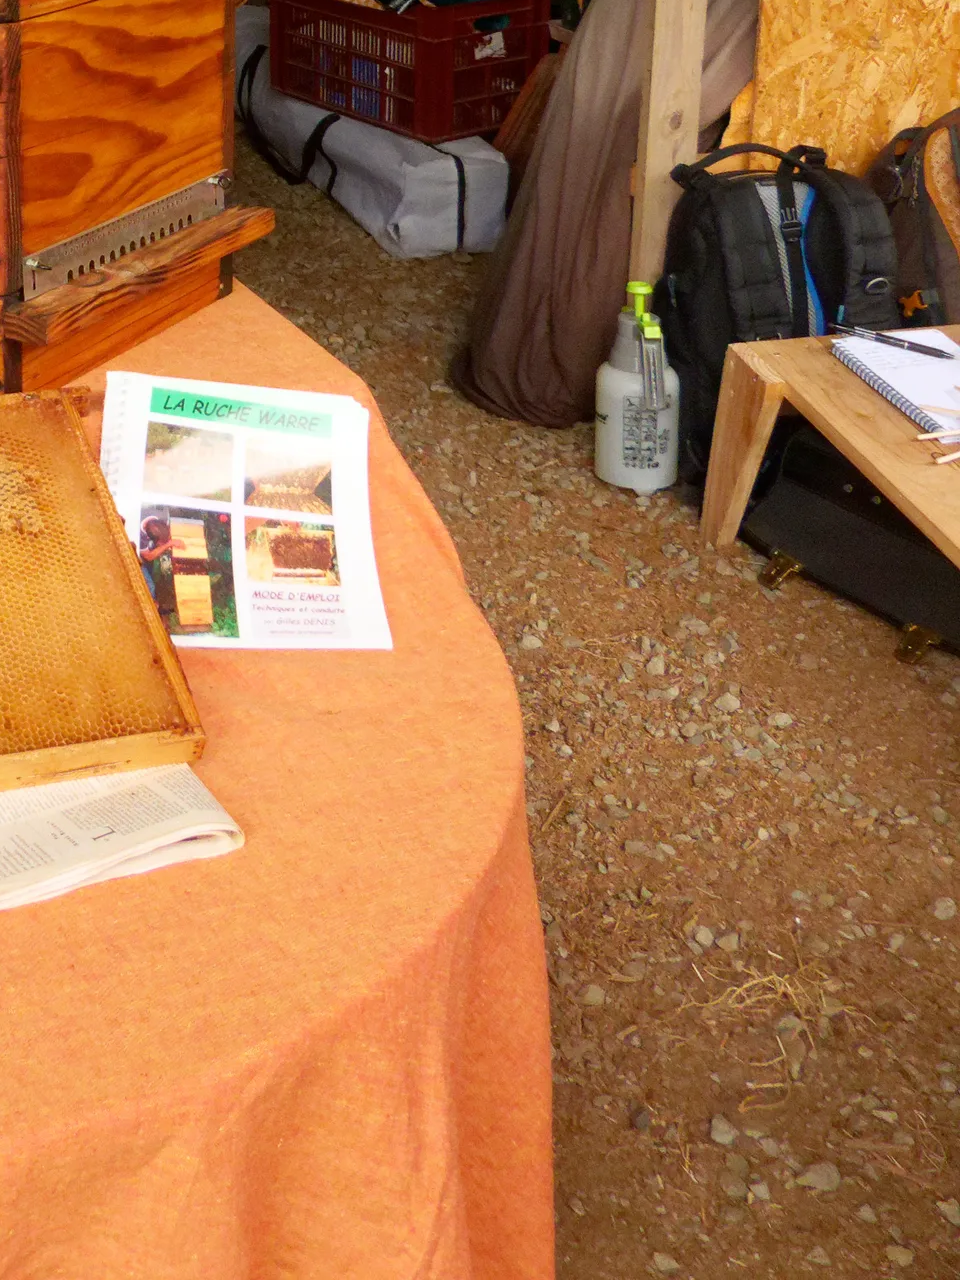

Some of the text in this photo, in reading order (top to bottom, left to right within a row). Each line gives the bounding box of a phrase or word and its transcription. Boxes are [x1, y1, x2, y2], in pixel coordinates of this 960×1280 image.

[163, 394, 321, 433] LA RUCHE WARRE
[252, 590, 340, 603] MODE D'EMPLOI
